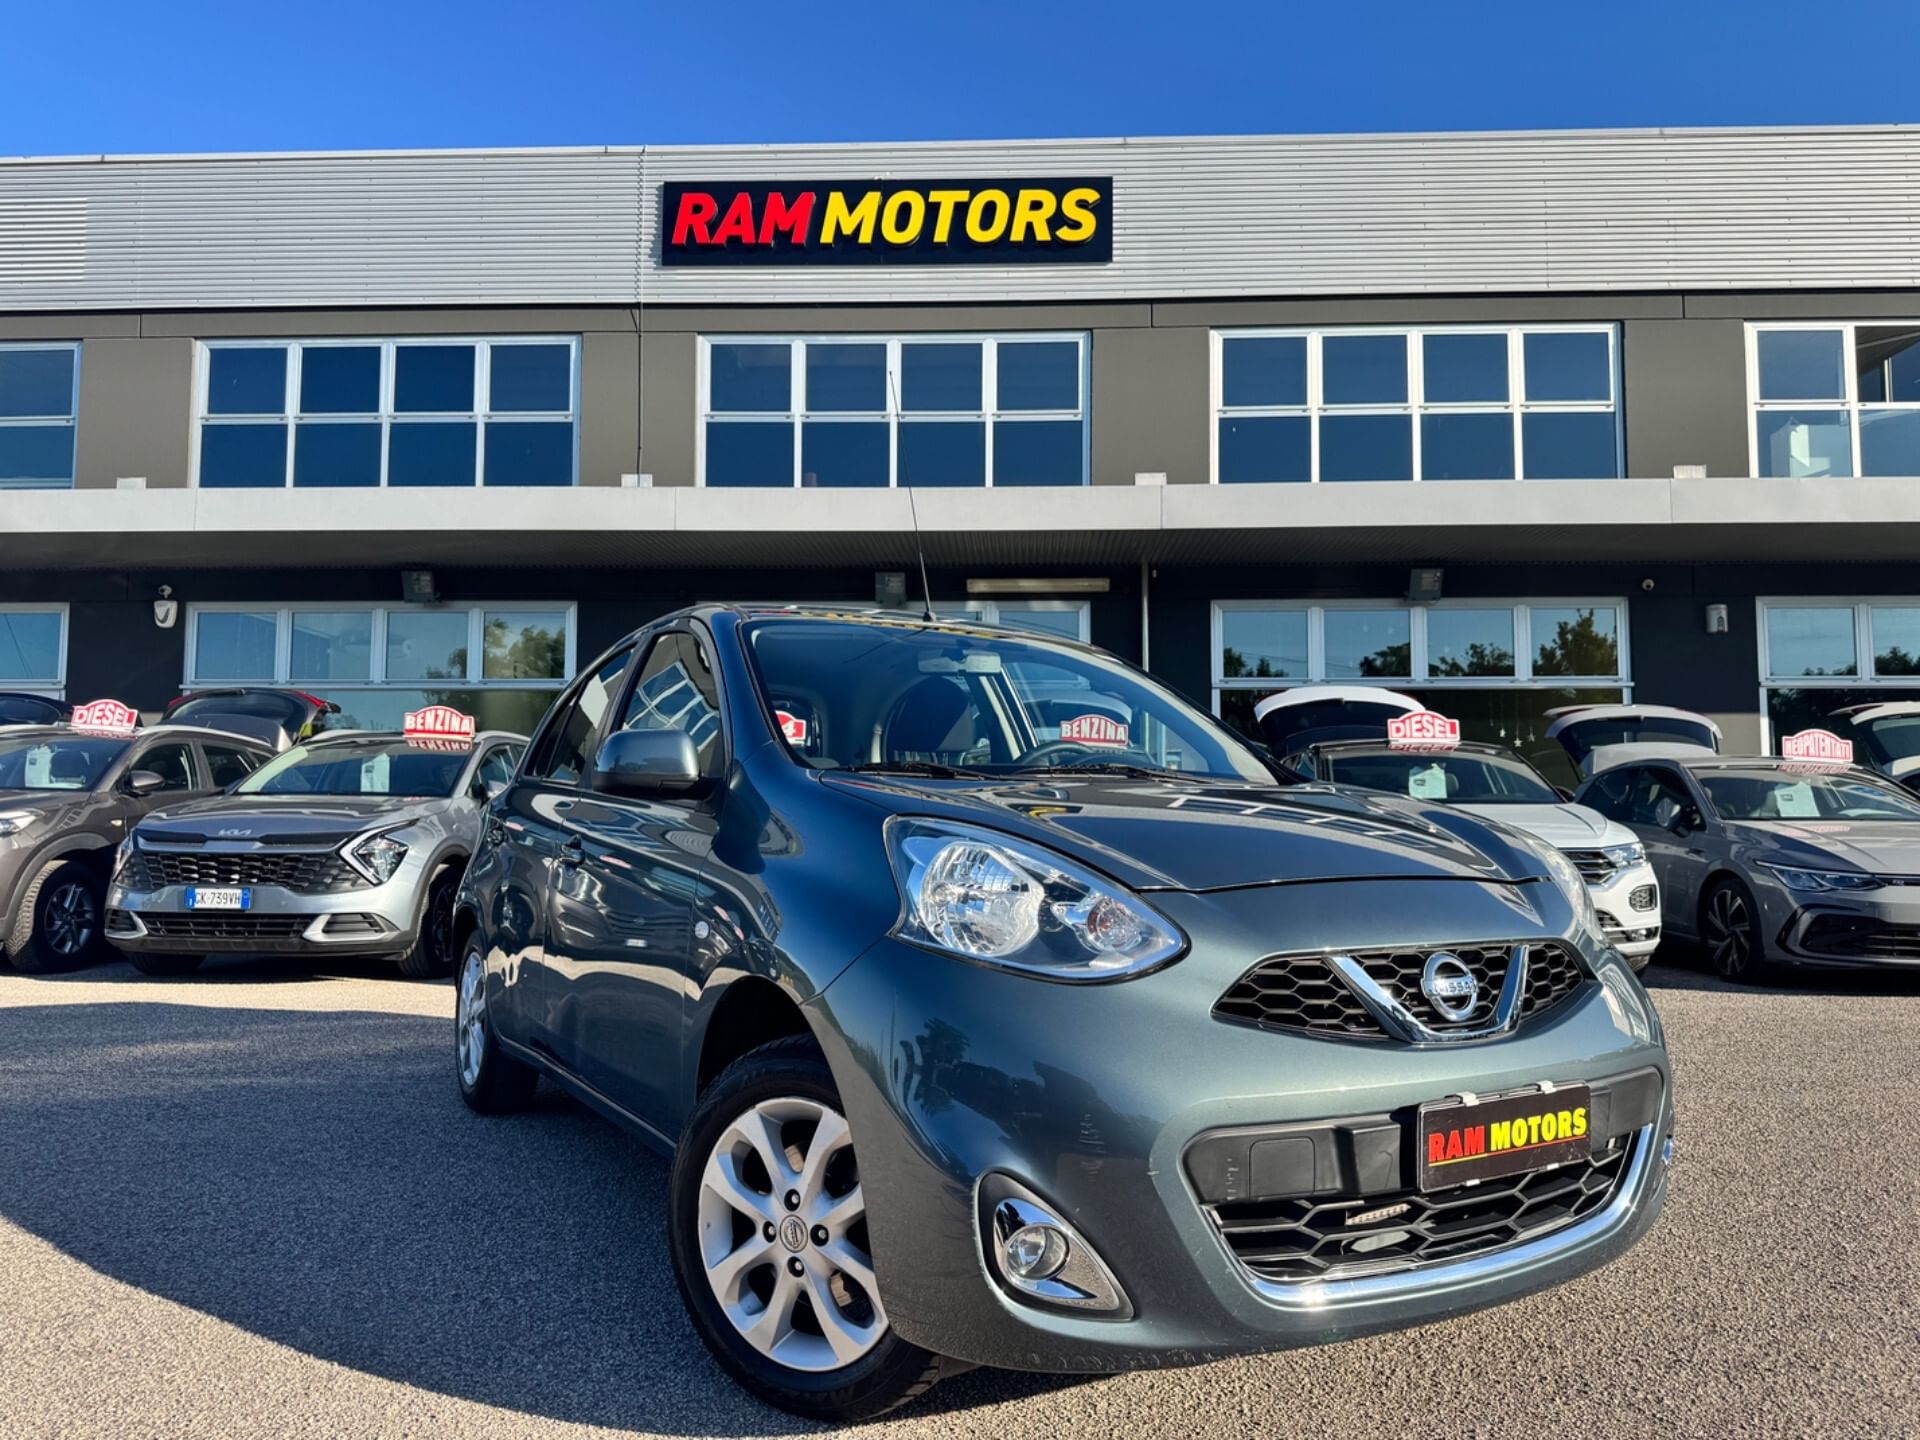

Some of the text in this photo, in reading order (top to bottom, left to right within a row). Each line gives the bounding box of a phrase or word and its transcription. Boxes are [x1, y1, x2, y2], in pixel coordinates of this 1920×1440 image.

[671, 187, 1102, 246] RAM MOTORS
[72, 702, 134, 726] DIESEL
[405, 709, 470, 732] BENZINA
[1061, 717, 1126, 741] BENZINA
[1390, 714, 1457, 739] DIESEL
[1428, 1107, 1587, 1161] RAM MOTORS
